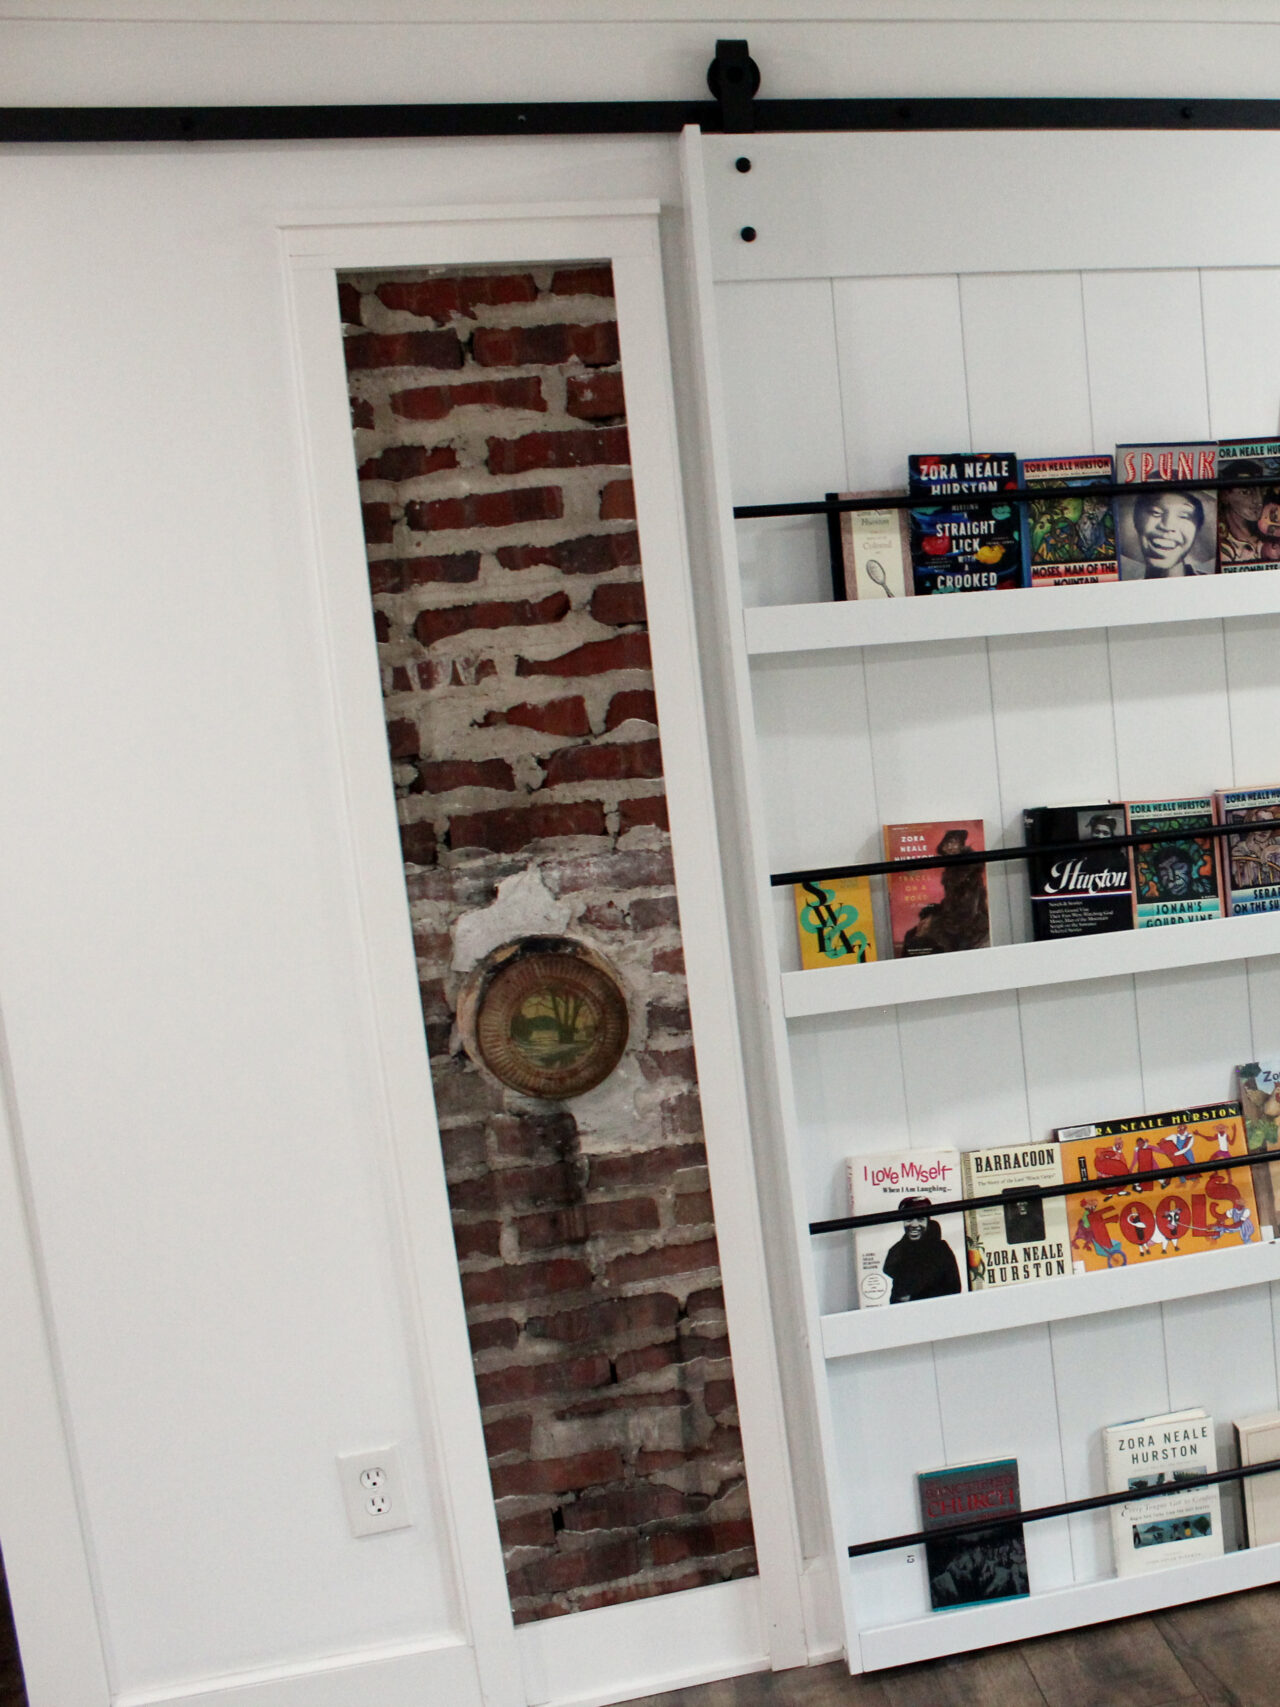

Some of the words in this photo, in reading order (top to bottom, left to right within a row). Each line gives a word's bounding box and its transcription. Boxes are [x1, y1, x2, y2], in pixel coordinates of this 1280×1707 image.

[1239, 445, 1265, 457] NEALE
[920, 463, 958, 481] ZORA
[964, 460, 1009, 479] NEALE
[1024, 463, 1048, 474] ZORA
[1049, 461, 1073, 472] NEALE
[1074, 458, 1110, 470] HURSTON
[1124, 451, 1216, 483] SPUNK
[935, 520, 997, 538] STRAIGHT
[952, 537, 981, 554] LICK
[1064, 563, 1085, 575] MAN
[1086, 562, 1099, 574] OF
[1100, 561, 1117, 573] THE
[936, 571, 998, 590] CROOKED
[1225, 793, 1246, 804] ZORA
[1247, 790, 1270, 801] NEALE
[1130, 804, 1150, 814] ZORA
[1152, 802, 1176, 812] NEALE
[1177, 800, 1211, 811] HURSTON
[901, 835, 926, 843] ZORA
[900, 845, 928, 853] NEALE
[1043, 857, 1128, 895] Hurston
[1155, 900, 1202, 915] JONAH'S
[1233, 903, 1249, 914] ON
[1250, 901, 1266, 913] THE
[1146, 916, 1184, 929] GOURD
[1120, 1115, 1164, 1133] NEALE
[1171, 1106, 1238, 1125] HURSTON
[974, 1148, 1055, 1174] BARRACOON
[863, 1165, 868, 1181] I
[901, 1160, 953, 1183] Myself
[985, 1249, 1018, 1268] ZORA
[1023, 1243, 1064, 1263] NEALE
[987, 1259, 1066, 1284] HURSTON
[1118, 1434, 1156, 1451] ZORA
[1163, 1426, 1209, 1444] NEALE
[1131, 1443, 1199, 1465] HURSTON
[927, 1487, 1015, 1518] CHURCH
